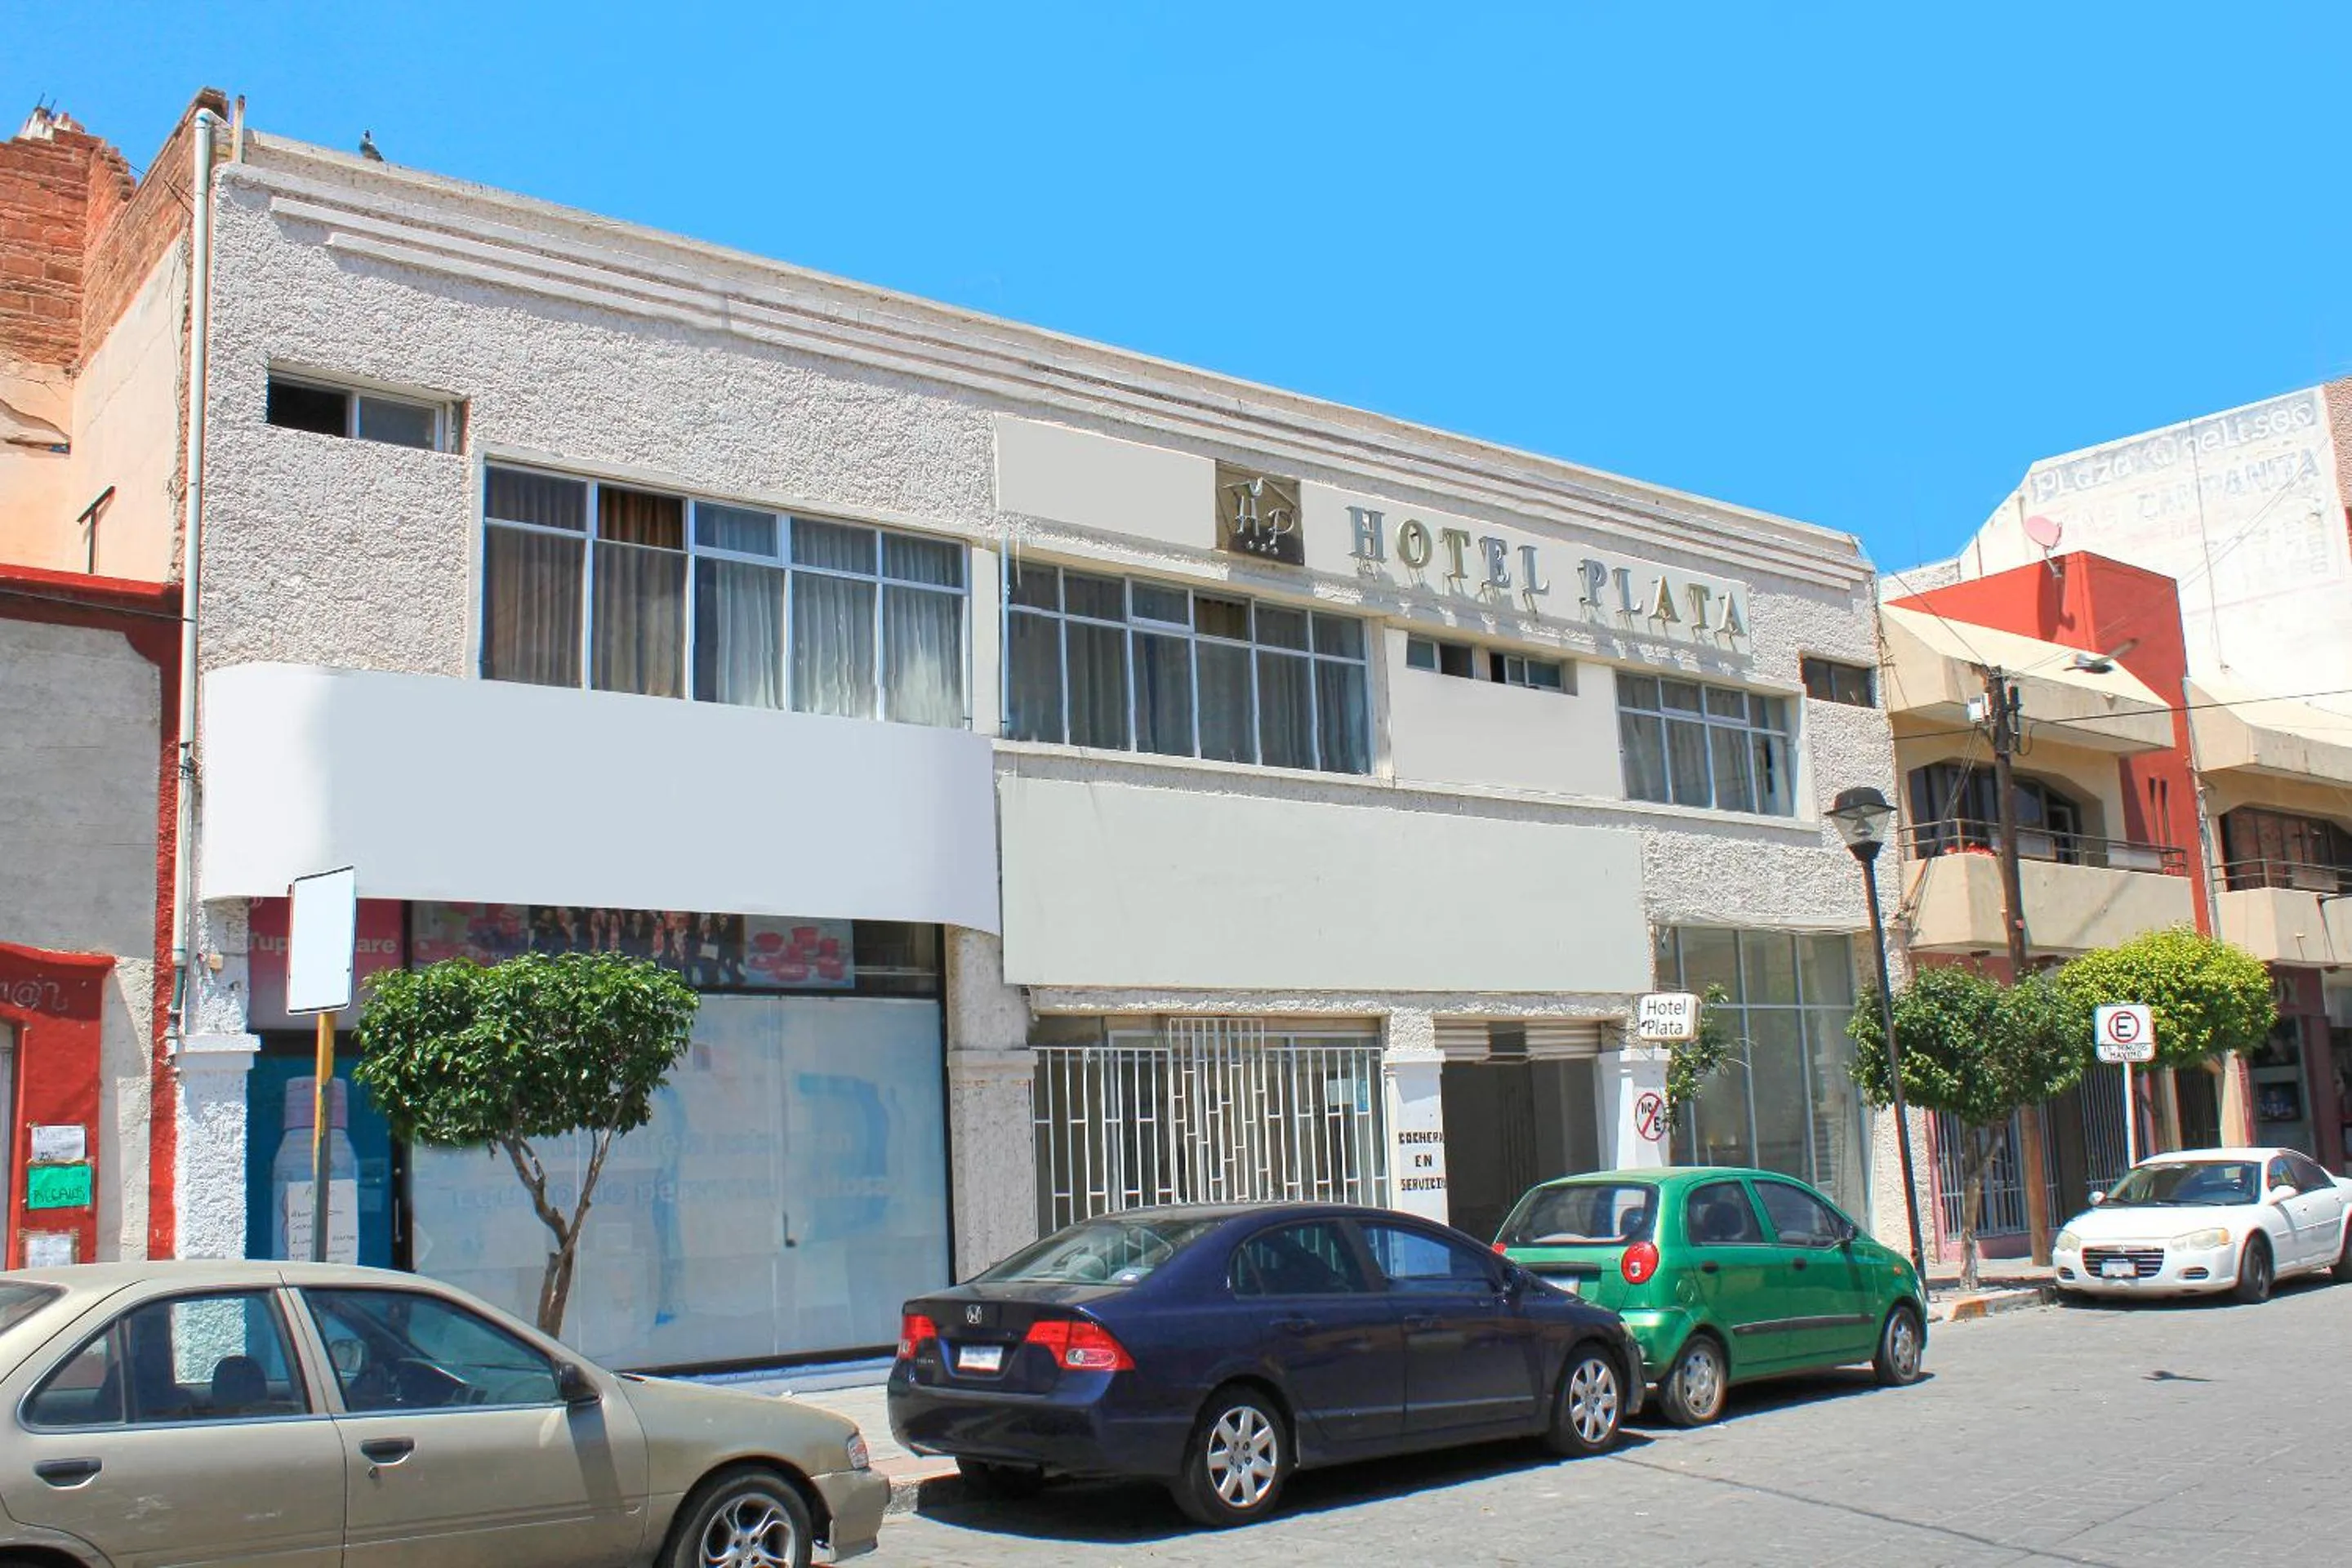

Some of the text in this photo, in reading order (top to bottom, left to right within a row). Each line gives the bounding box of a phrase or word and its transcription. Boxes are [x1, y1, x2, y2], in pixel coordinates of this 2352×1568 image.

[1347, 505, 1748, 636] HOTEL PLATA
[248, 931, 399, 956] Tupare
[1646, 999, 1686, 1016] Hotel
[1646, 1019, 1683, 1036] Plata
[2116, 1015, 2132, 1037] E
[1414, 1154, 1432, 1168] EN
[1401, 1177, 1445, 1192] SERVICI
